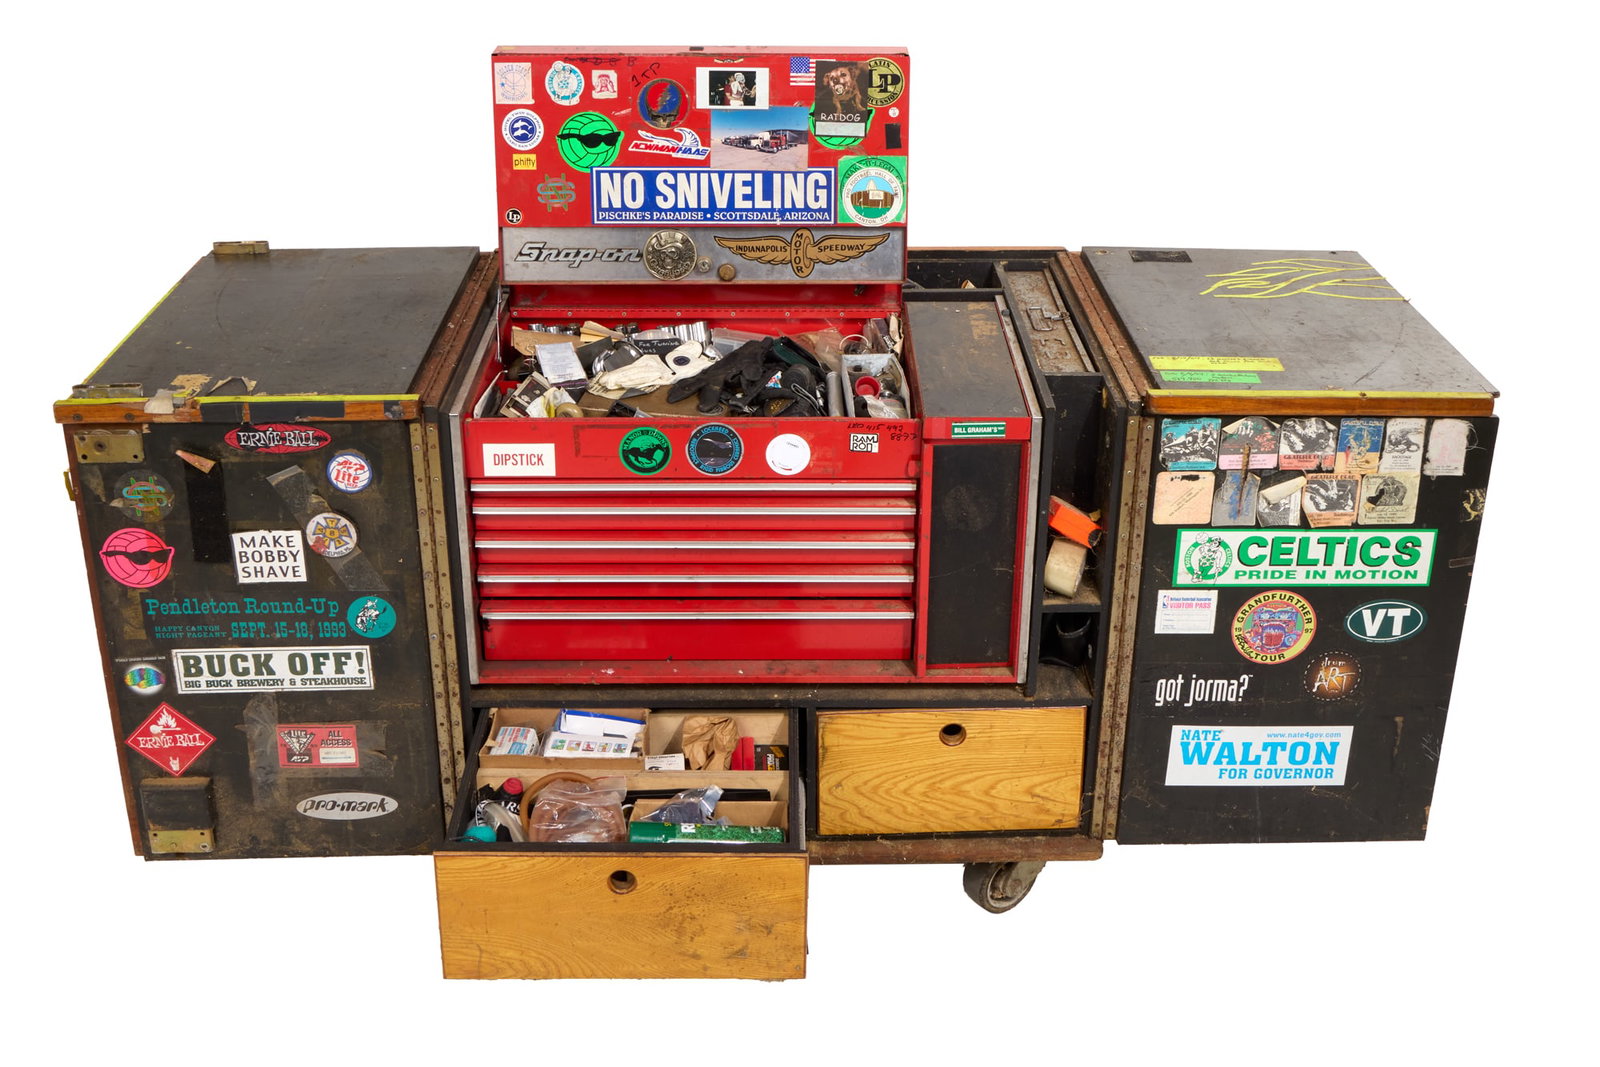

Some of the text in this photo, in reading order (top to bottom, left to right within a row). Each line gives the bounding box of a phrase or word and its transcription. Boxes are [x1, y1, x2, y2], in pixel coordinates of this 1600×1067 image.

[820, 112, 861, 122] RATDOG
[600, 172, 828, 210] NO SNIVELING
[599, 211, 651, 221] PISCHKE'S
[653, 211, 704, 221] PARADISE
[784, 211, 830, 221] ARIZONA
[514, 241, 643, 269] Snap-on
[735, 245, 788, 253] INDIANAPOLIS
[794, 232, 804, 274] MOTOR
[817, 243, 865, 253] SPEEDWAY
[237, 427, 320, 447] ERNIE BALL
[493, 453, 545, 466] DIPSTICK
[334, 468, 360, 484] Lite
[240, 535, 297, 549] MAKE
[239, 550, 301, 564] BOBBY
[1237, 535, 1423, 567] CELTICS
[241, 565, 302, 578] SHAVE
[1234, 569, 1419, 580] PRIDE IN MOTION
[145, 597, 340, 617] Pendleton Round-Up
[1236, 593, 1313, 624] GRANDFURTHER
[1361, 608, 1412, 637] VT
[231, 621, 347, 640] SEPT. 15-18, 1993
[181, 651, 365, 678] BUCK OFF!
[1253, 653, 1286, 662] TOUR
[184, 677, 366, 688] BIG BUCK BREWERY & STEAKHOUSE
[1312, 666, 1356, 692] ART
[1154, 674, 1249, 707] got jorma?
[137, 733, 205, 749] ERNIE BALL
[328, 730, 344, 738] ALL
[1181, 729, 1342, 741] NATE www.nate4gov.com
[321, 738, 352, 747] ACCESS
[1180, 741, 1340, 766] WALTON
[1218, 768, 1334, 779] FOR GOVERNOR
